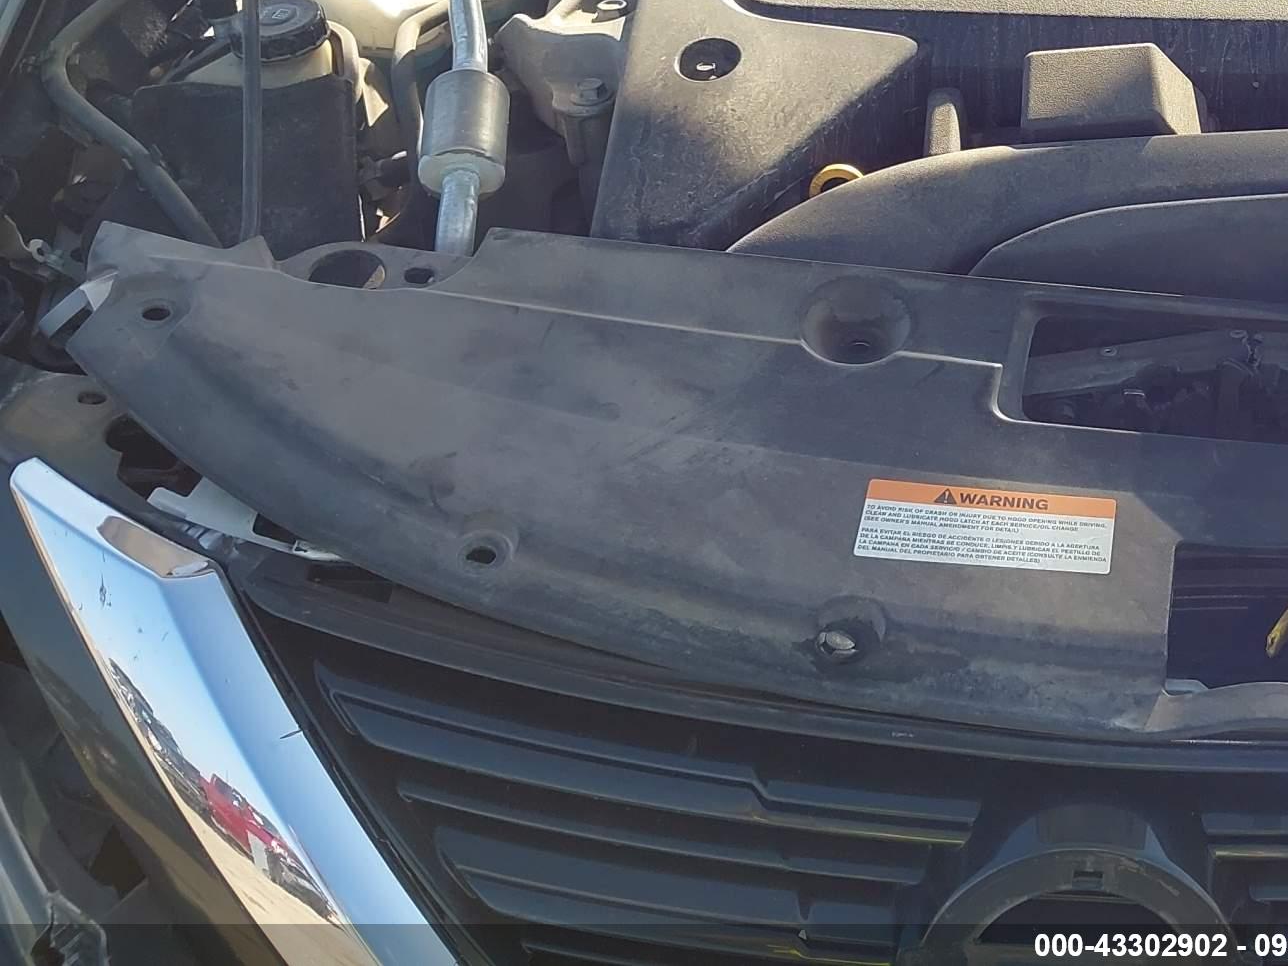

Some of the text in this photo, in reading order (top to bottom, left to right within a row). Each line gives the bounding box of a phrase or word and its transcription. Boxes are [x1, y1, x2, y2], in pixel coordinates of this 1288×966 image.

[959, 492, 1049, 511] WARNING
[1028, 517, 1057, 525] OPENING
[938, 522, 979, 530] AMENDMENT
[913, 549, 955, 557] PROPIETARIO
